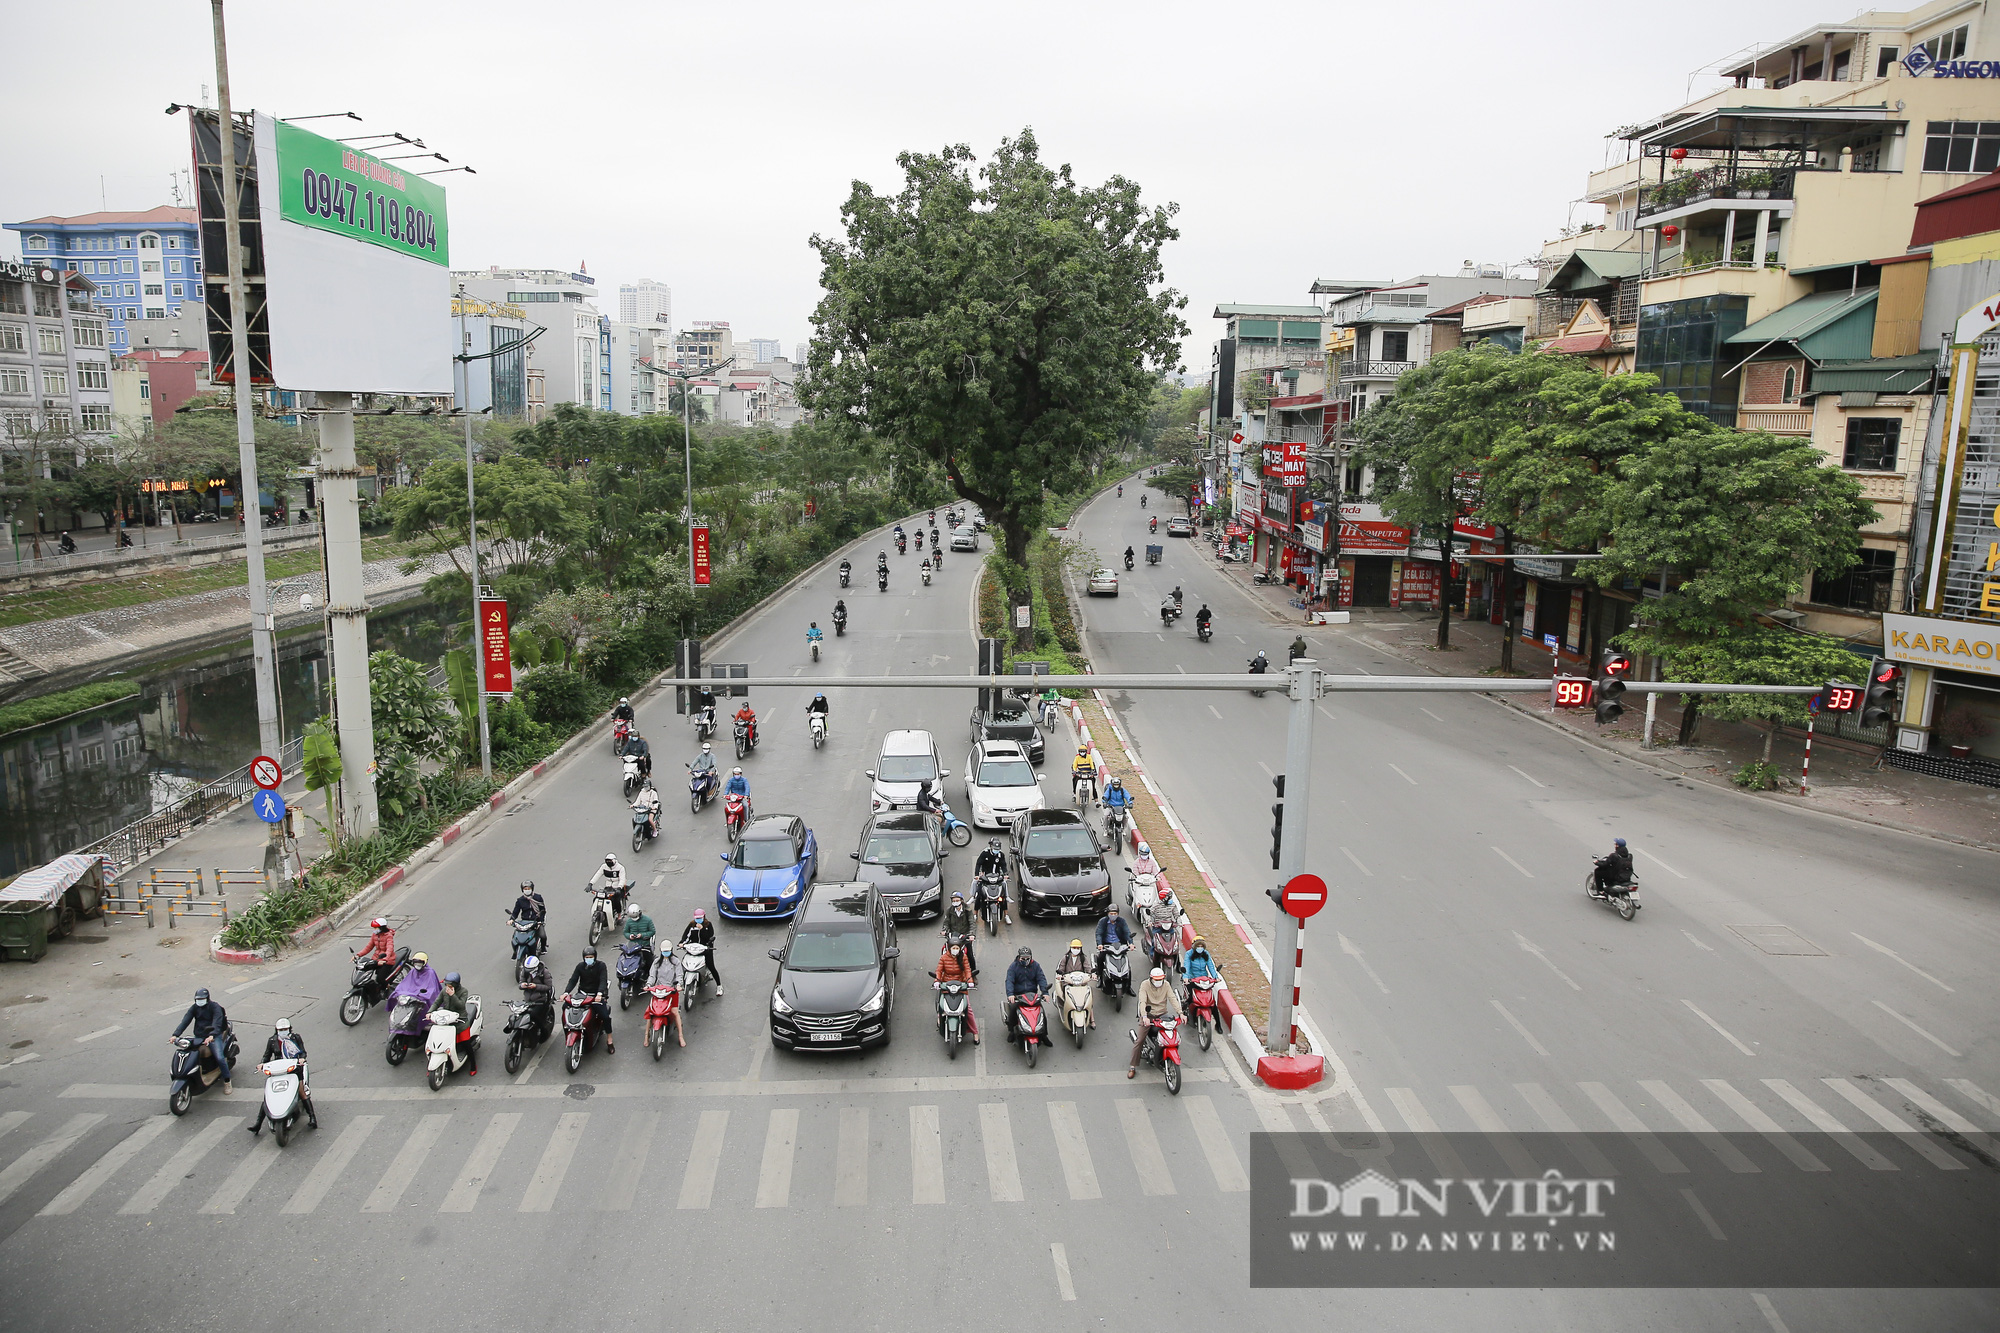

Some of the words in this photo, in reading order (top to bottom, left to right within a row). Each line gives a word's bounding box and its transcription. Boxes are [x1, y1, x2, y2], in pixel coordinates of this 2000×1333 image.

[342, 150, 359, 173] LIÊN
[360, 156, 369, 180] HỆ
[370, 159, 392, 186] QUẢNG
[303, 168, 437, 252] 0947.119.804
[1289, 445, 1300, 456] XE
[1284, 459, 1304, 472] MÁY
[1284, 475, 1305, 486] 50CC
[1891, 630, 2000, 662] KARAO
[1894, 652, 1908, 660] 140
[1557, 682, 1584, 704] 99
[1827, 688, 1855, 710] 33
